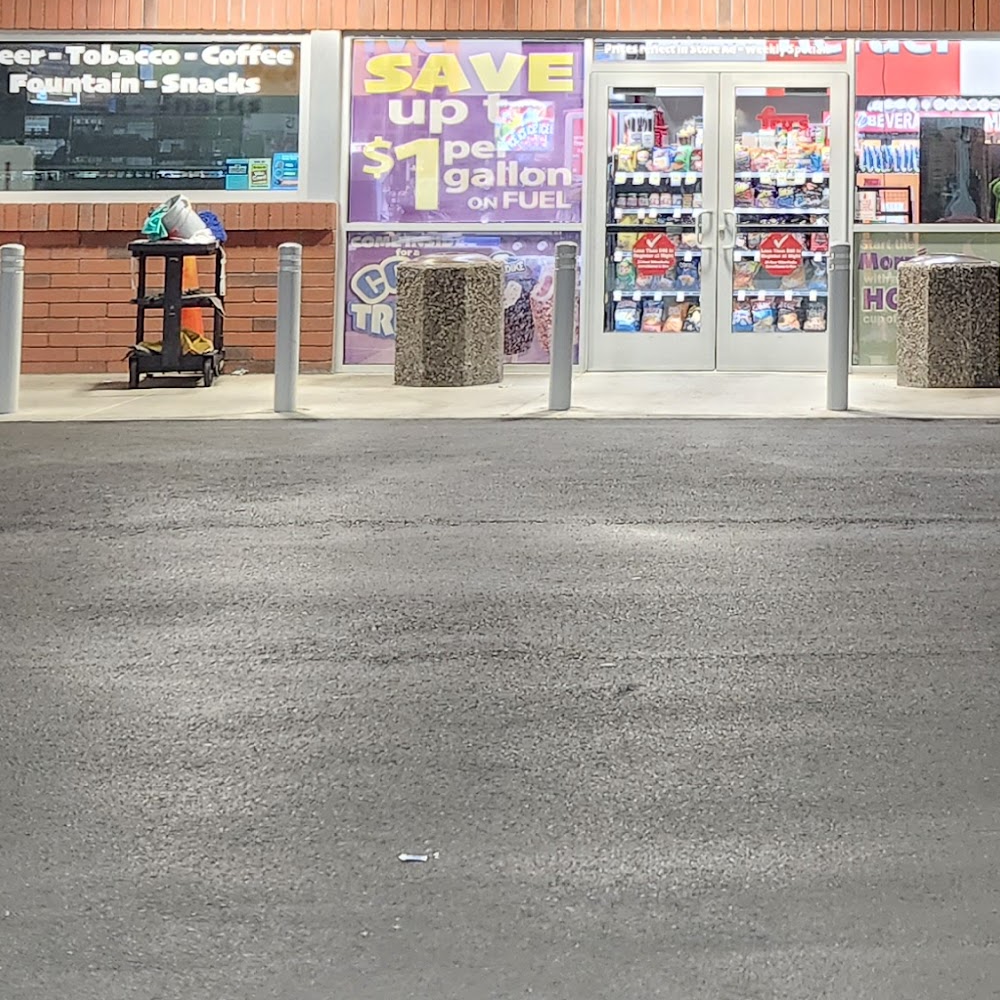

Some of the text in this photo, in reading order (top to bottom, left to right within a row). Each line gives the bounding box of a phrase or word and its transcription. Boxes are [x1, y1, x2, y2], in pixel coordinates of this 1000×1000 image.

[65, 45, 181, 66] Tobacco
[201, 44, 295, 66] Coffee
[9, 73, 141, 94] Fountain
[161, 71, 261, 95] Snacks
[364, 53, 574, 93] SAVE
[388, 98, 469, 134] up
[362, 136, 440, 211] $1
[443, 161, 572, 193] gallon
[467, 191, 572, 210] ON FUEL
